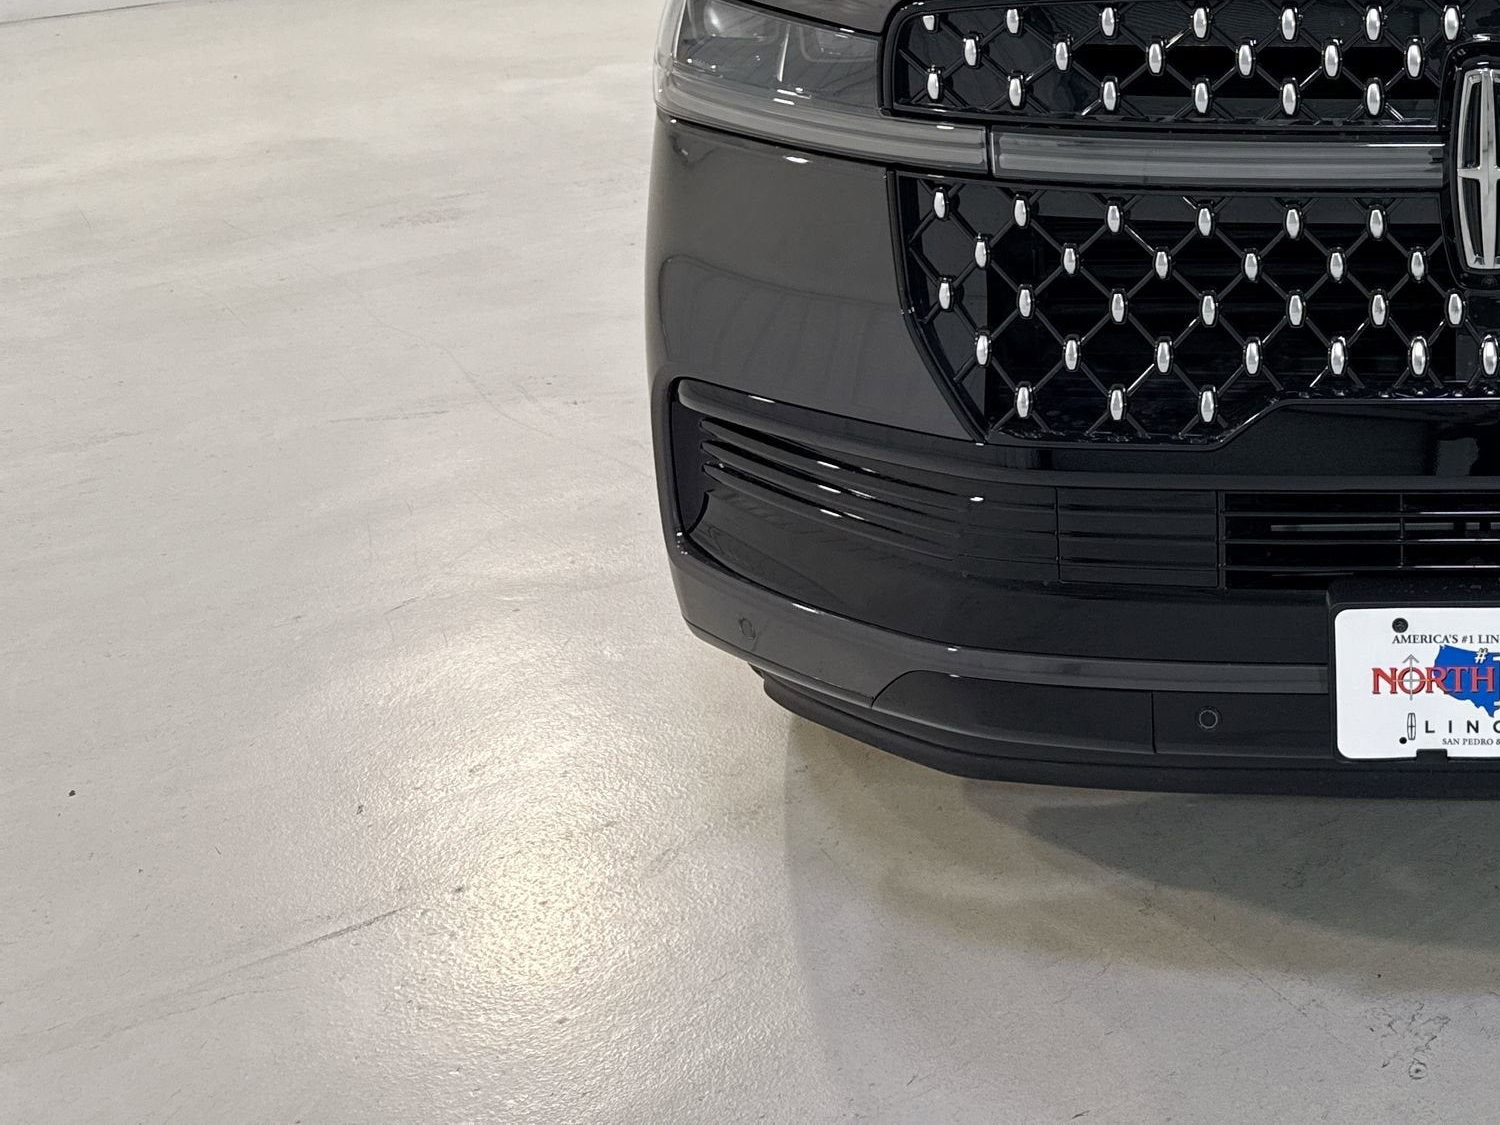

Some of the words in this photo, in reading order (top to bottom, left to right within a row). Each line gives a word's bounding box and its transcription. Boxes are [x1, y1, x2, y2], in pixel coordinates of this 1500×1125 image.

[1392, 634, 1458, 645] AMERICA'S
[1461, 634, 1475, 645] #1
[1371, 666, 1495, 695] NORTH
[1442, 737, 1460, 746] SAN
[1462, 737, 1493, 746] PEDRO
